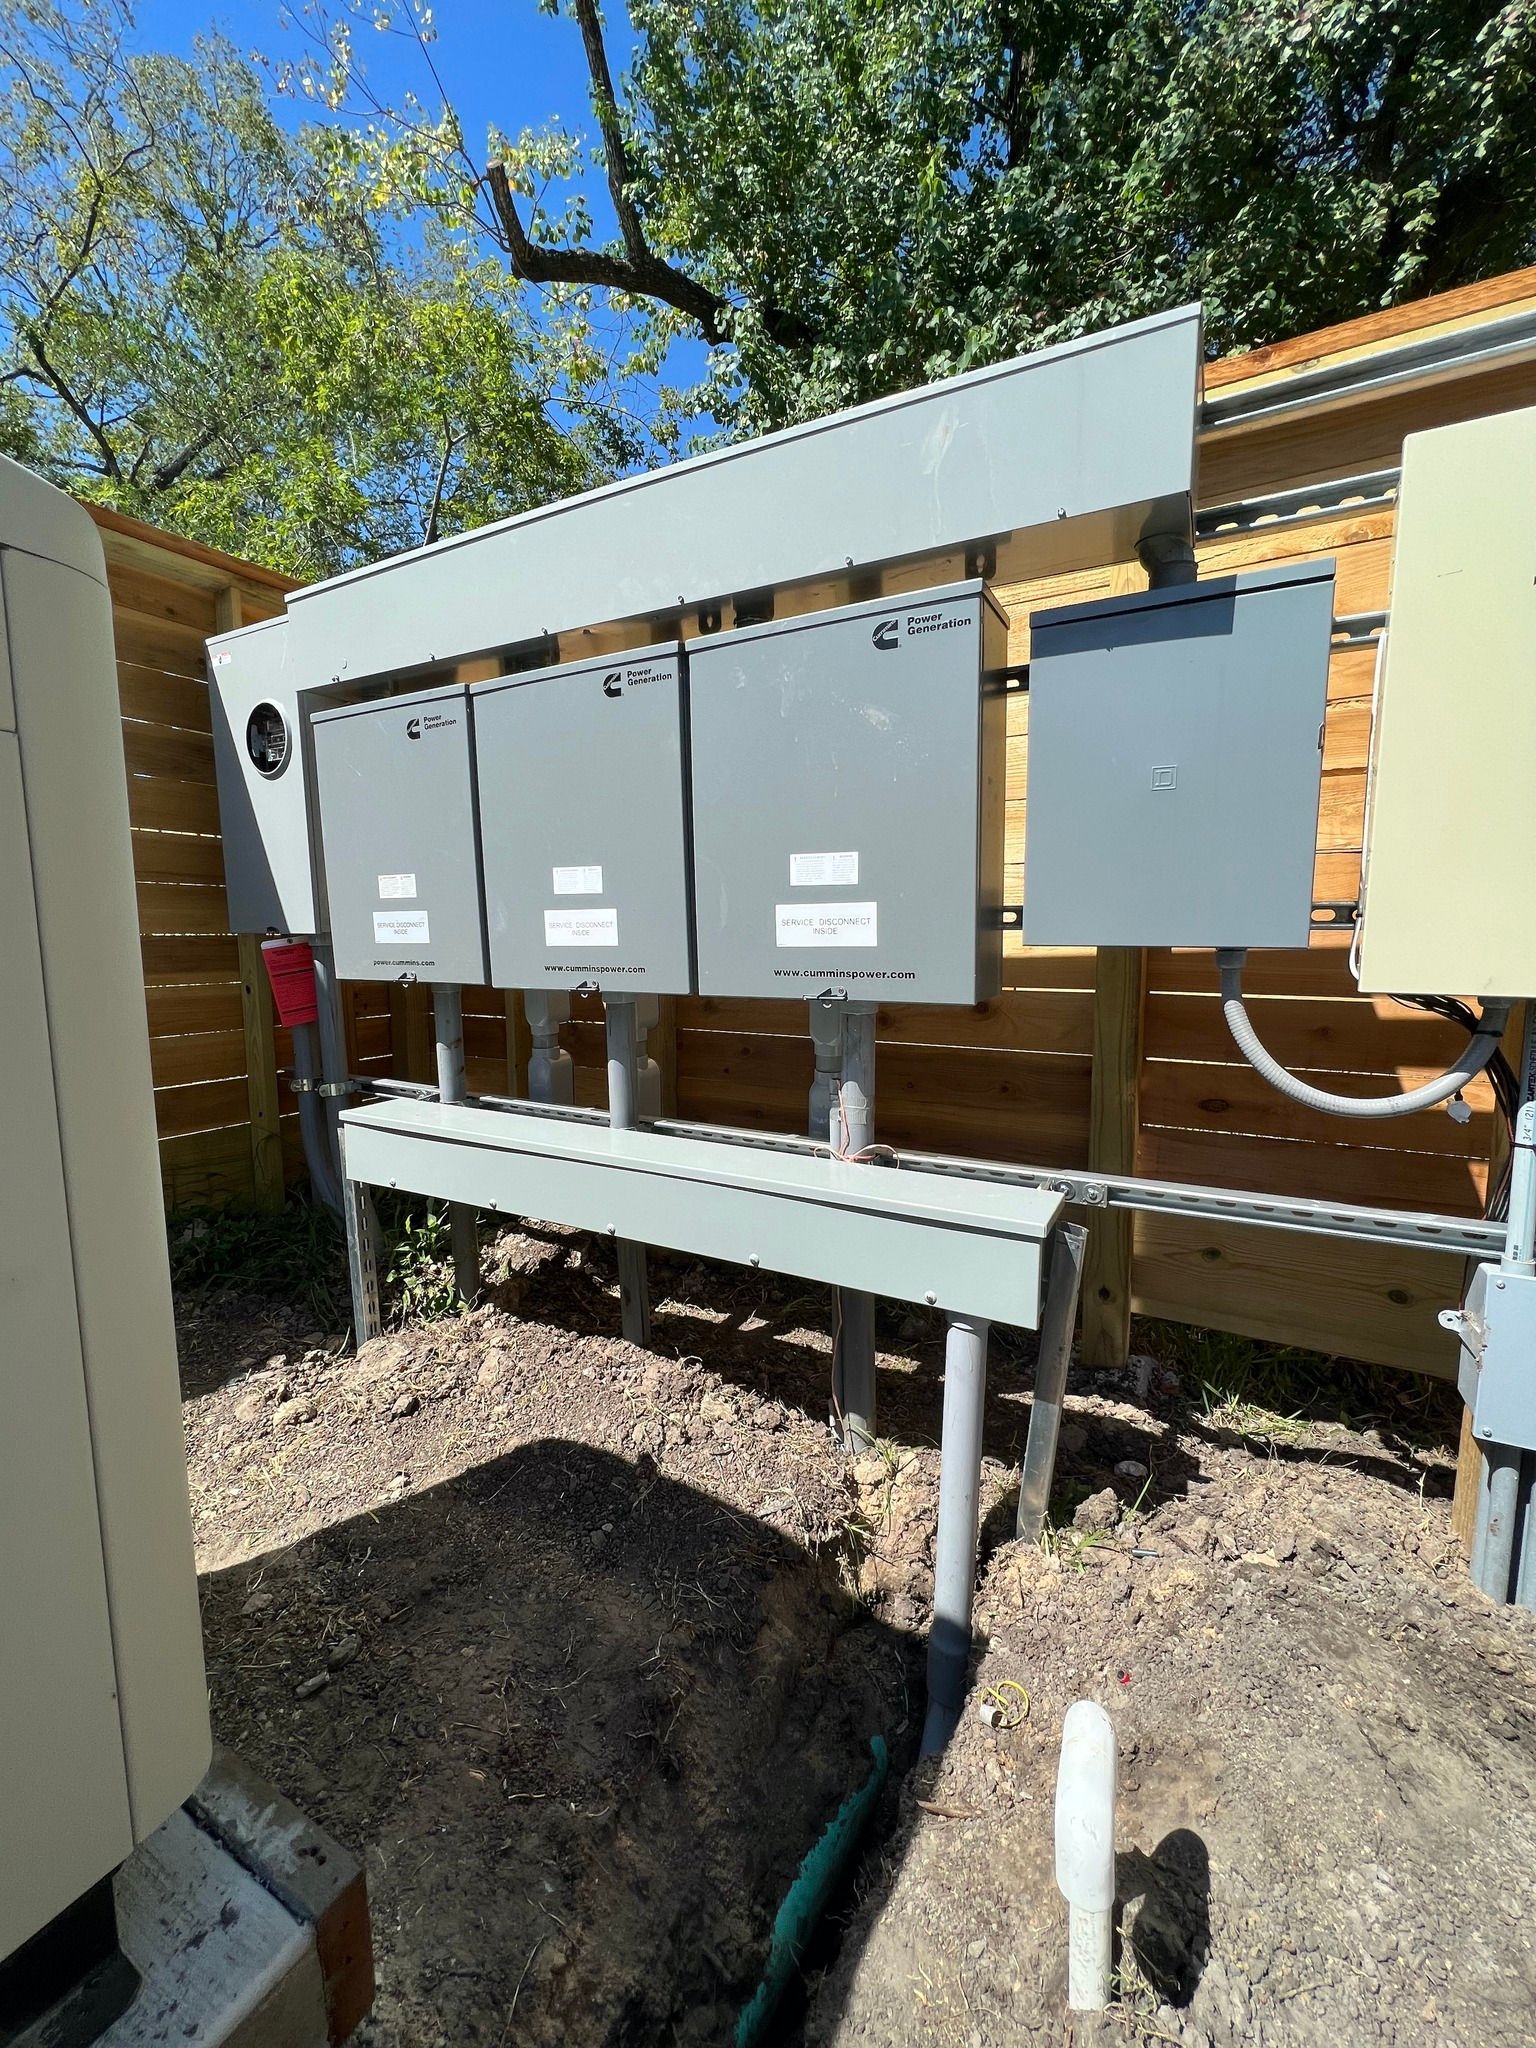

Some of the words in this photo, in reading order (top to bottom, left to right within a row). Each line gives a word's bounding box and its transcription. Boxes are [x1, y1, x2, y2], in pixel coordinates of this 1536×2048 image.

[907, 613, 942, 626] Power
[907, 618, 971, 636] Generation
[627, 668, 652, 678] Power
[627, 673, 672, 686] Generation
[423, 715, 442, 723] Power
[424, 720, 457, 730] Generation
[575, 921, 613, 929] DISCONNECT
[818, 917, 871, 926] DISCONNECT
[544, 965, 646, 974] www.cumminspower.com
[773, 969, 916, 980] www.cumminspower.com
